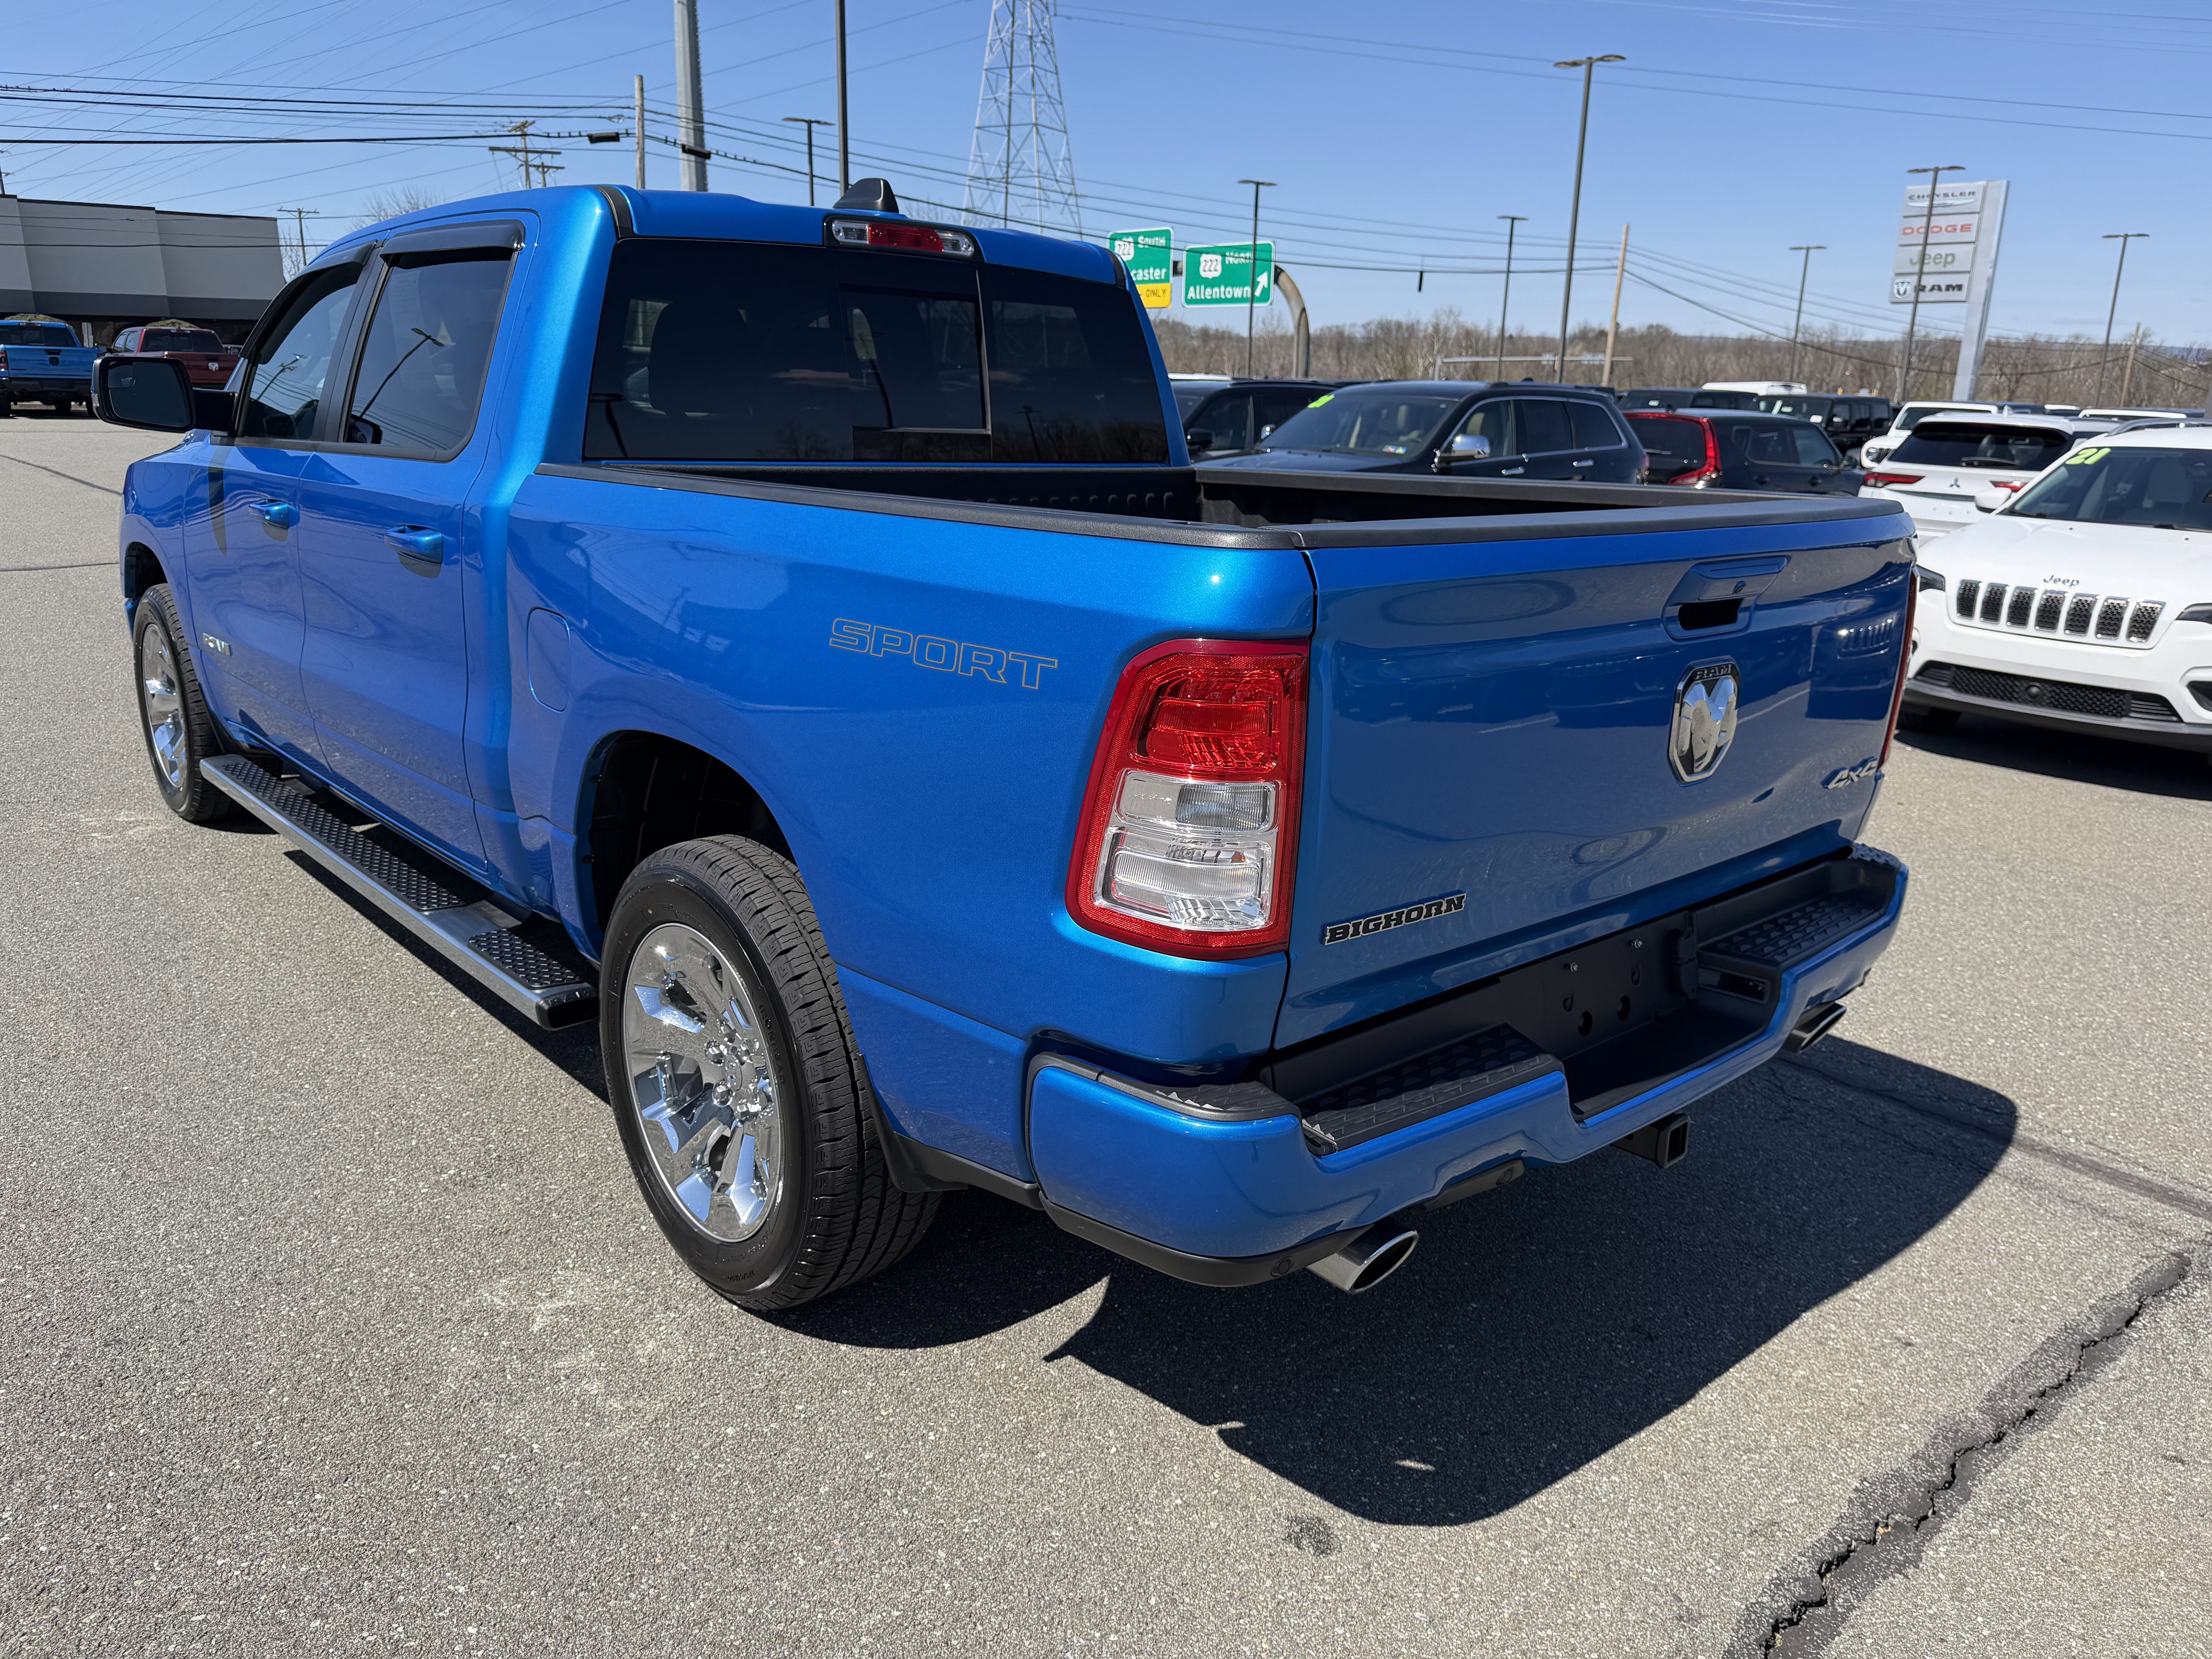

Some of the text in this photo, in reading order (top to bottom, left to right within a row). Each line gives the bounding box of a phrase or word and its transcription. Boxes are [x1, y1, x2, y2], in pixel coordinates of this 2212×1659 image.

[1902, 223, 1972, 235] DODGE
[1202, 259, 1218, 272] 222
[1908, 250, 1955, 269] Jeep
[1130, 266, 1167, 281] caster
[1187, 284, 1251, 299] Allentown
[1914, 284, 1963, 292] RAM
[2065, 448, 2112, 465] 21
[2043, 575, 2080, 587] Jeep
[829, 618, 1058, 690] SPORT
[1695, 664, 1732, 680] RAM
[1324, 892, 1467, 946] BIGHORN
